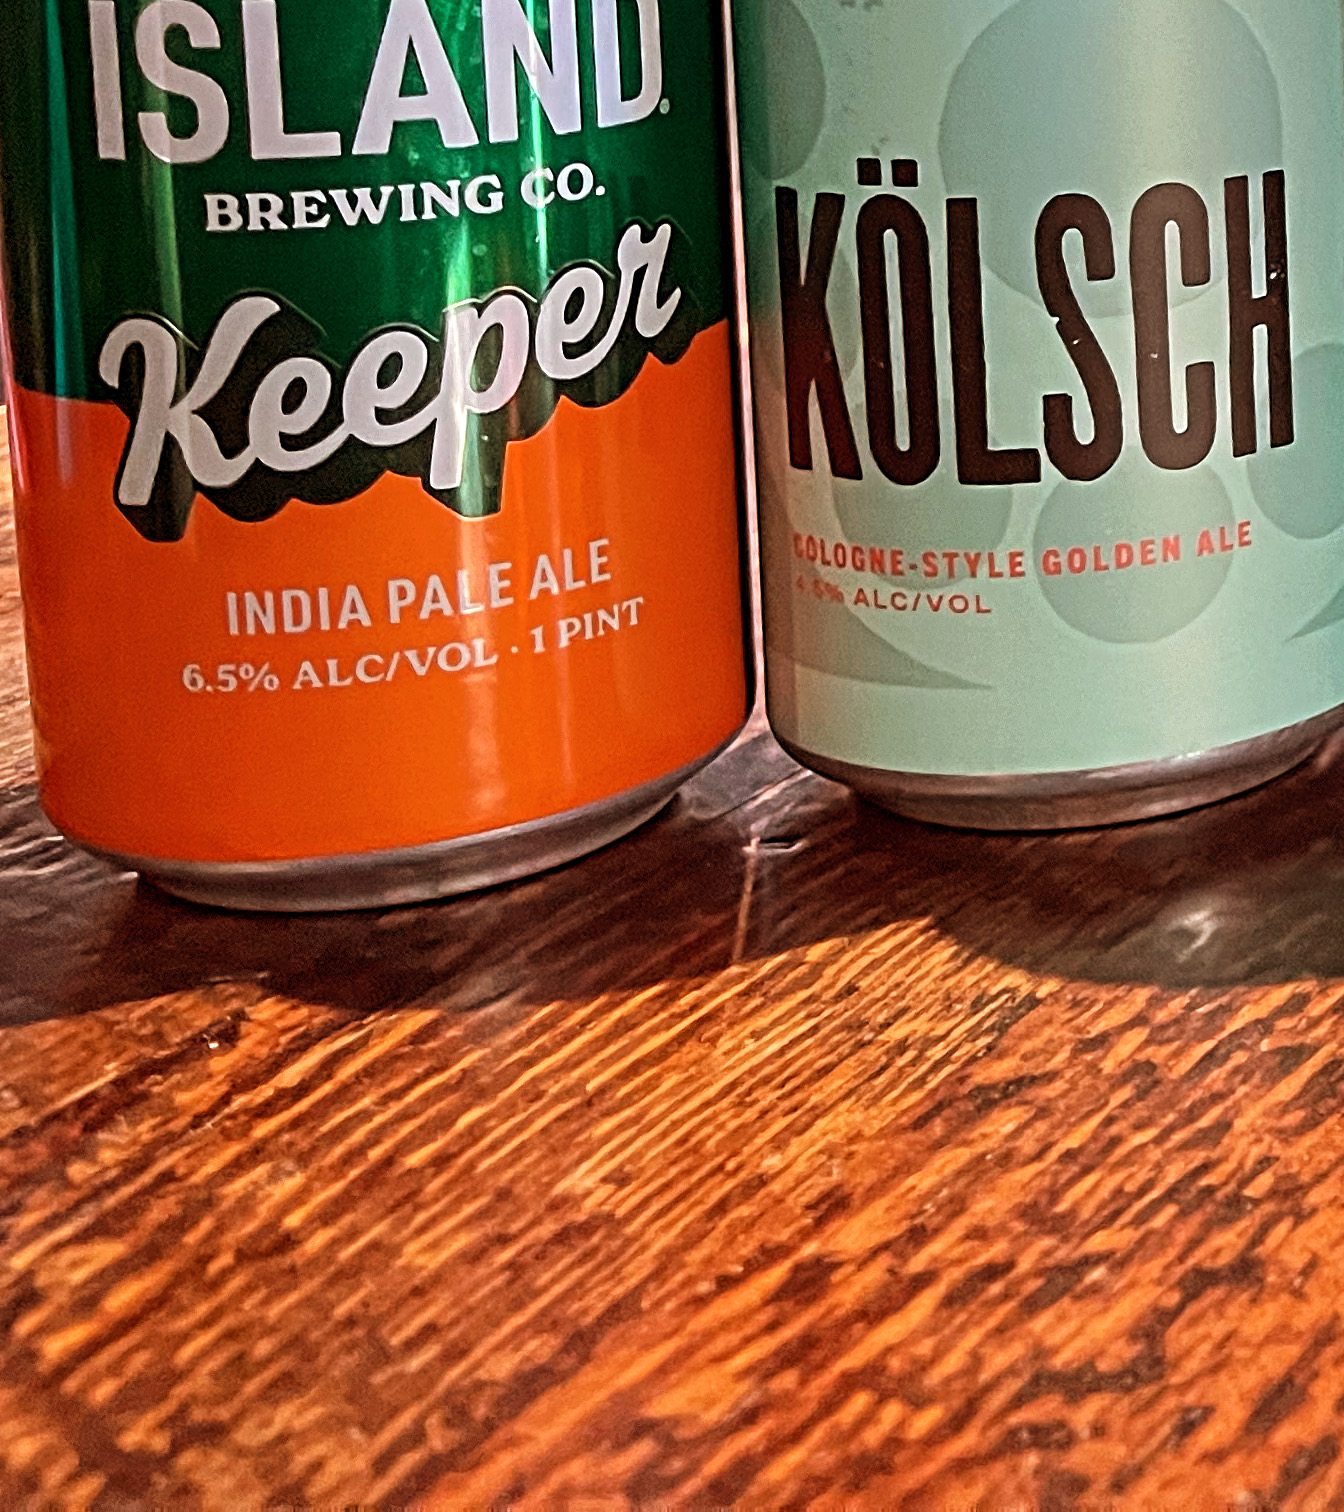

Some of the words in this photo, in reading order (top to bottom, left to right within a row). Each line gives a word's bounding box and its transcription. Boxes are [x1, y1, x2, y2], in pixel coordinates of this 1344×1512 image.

[204, 175, 503, 233] BREWING
[521, 162, 605, 207] CO.
[99, 222, 681, 506] Keeper
[774, 156, 1295, 488] KÖLSCH
[226, 590, 372, 637] INDIA
[388, 562, 513, 624] PALE
[528, 538, 612, 600] ALE
[793, 532, 1026, 579] COLOGNE-STYLE
[1041, 534, 1182, 576] GOLDEN
[1196, 520, 1253, 558] ALE
[182, 662, 280, 694] 6.5%
[292, 638, 498, 691] ALC/VOL
[530, 626, 545, 655] 1
[557, 597, 644, 649] PINT
[853, 588, 992, 614] ALC/VOL
